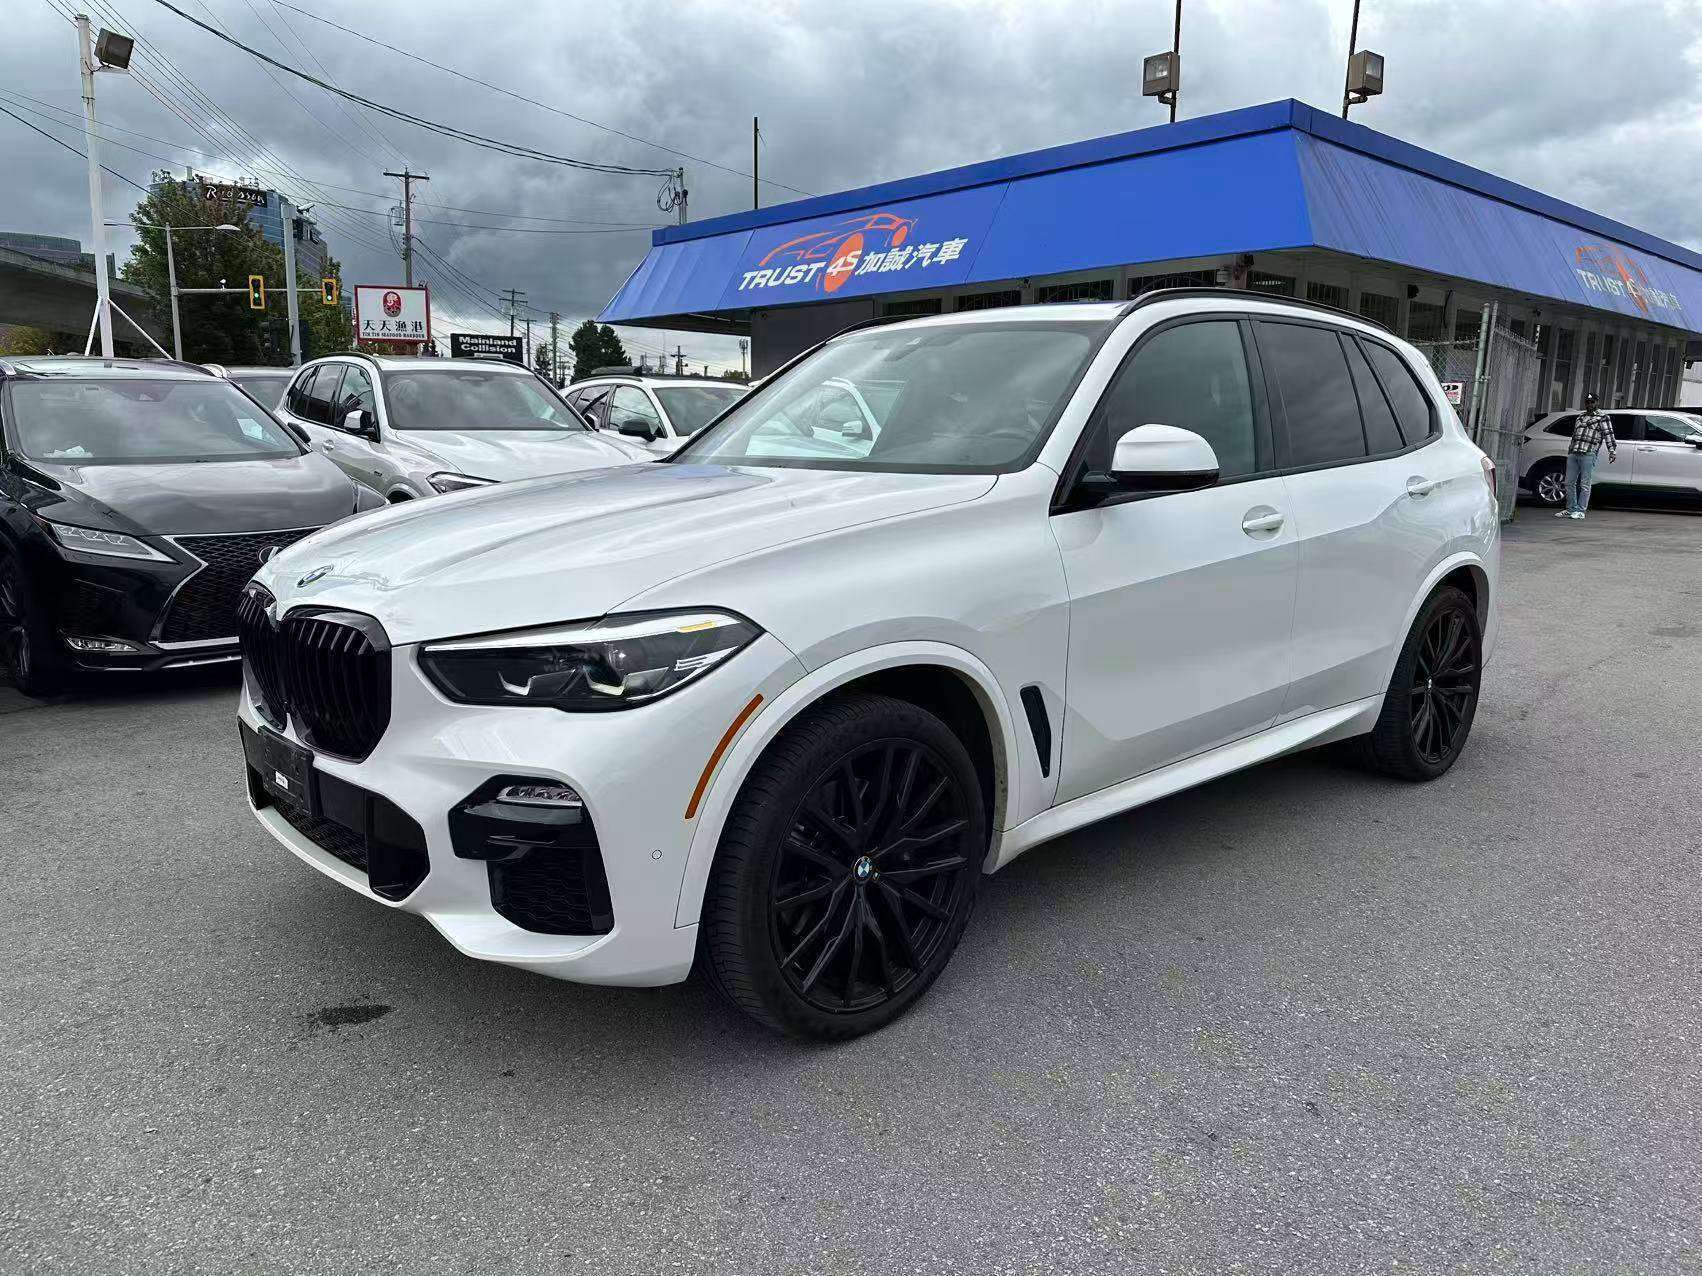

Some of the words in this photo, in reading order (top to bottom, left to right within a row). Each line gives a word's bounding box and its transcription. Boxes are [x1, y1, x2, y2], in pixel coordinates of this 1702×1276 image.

[738, 262, 827, 291] TRUST
[826, 249, 862, 277] 4S
[855, 238, 968, 276] 加誠汽車
[363, 319, 423, 332] 天天漁港
[459, 336, 517, 346] Mainland
[461, 344, 516, 353] Collision
